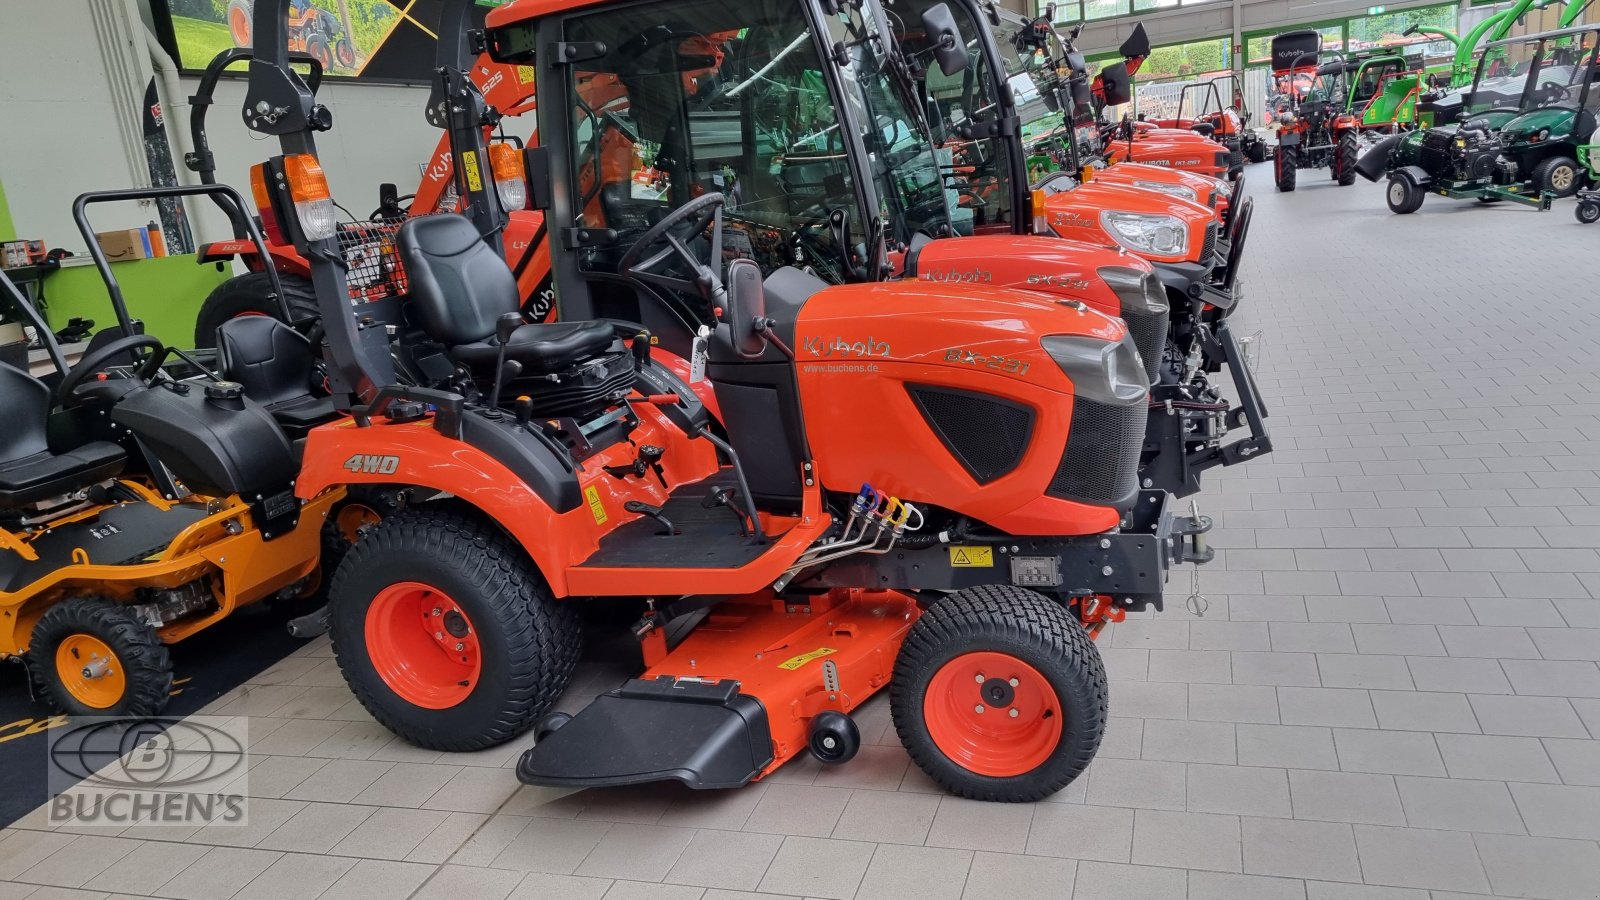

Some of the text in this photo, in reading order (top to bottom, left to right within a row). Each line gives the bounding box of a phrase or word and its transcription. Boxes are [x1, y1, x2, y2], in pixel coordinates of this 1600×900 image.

[481, 71, 504, 95] 525
[927, 267, 992, 284] Kubota
[803, 336, 891, 358] Kubota
[803, 363, 879, 373] www.buchens.de
[943, 348, 1031, 376] BX-231
[343, 453, 401, 475] 4WD
